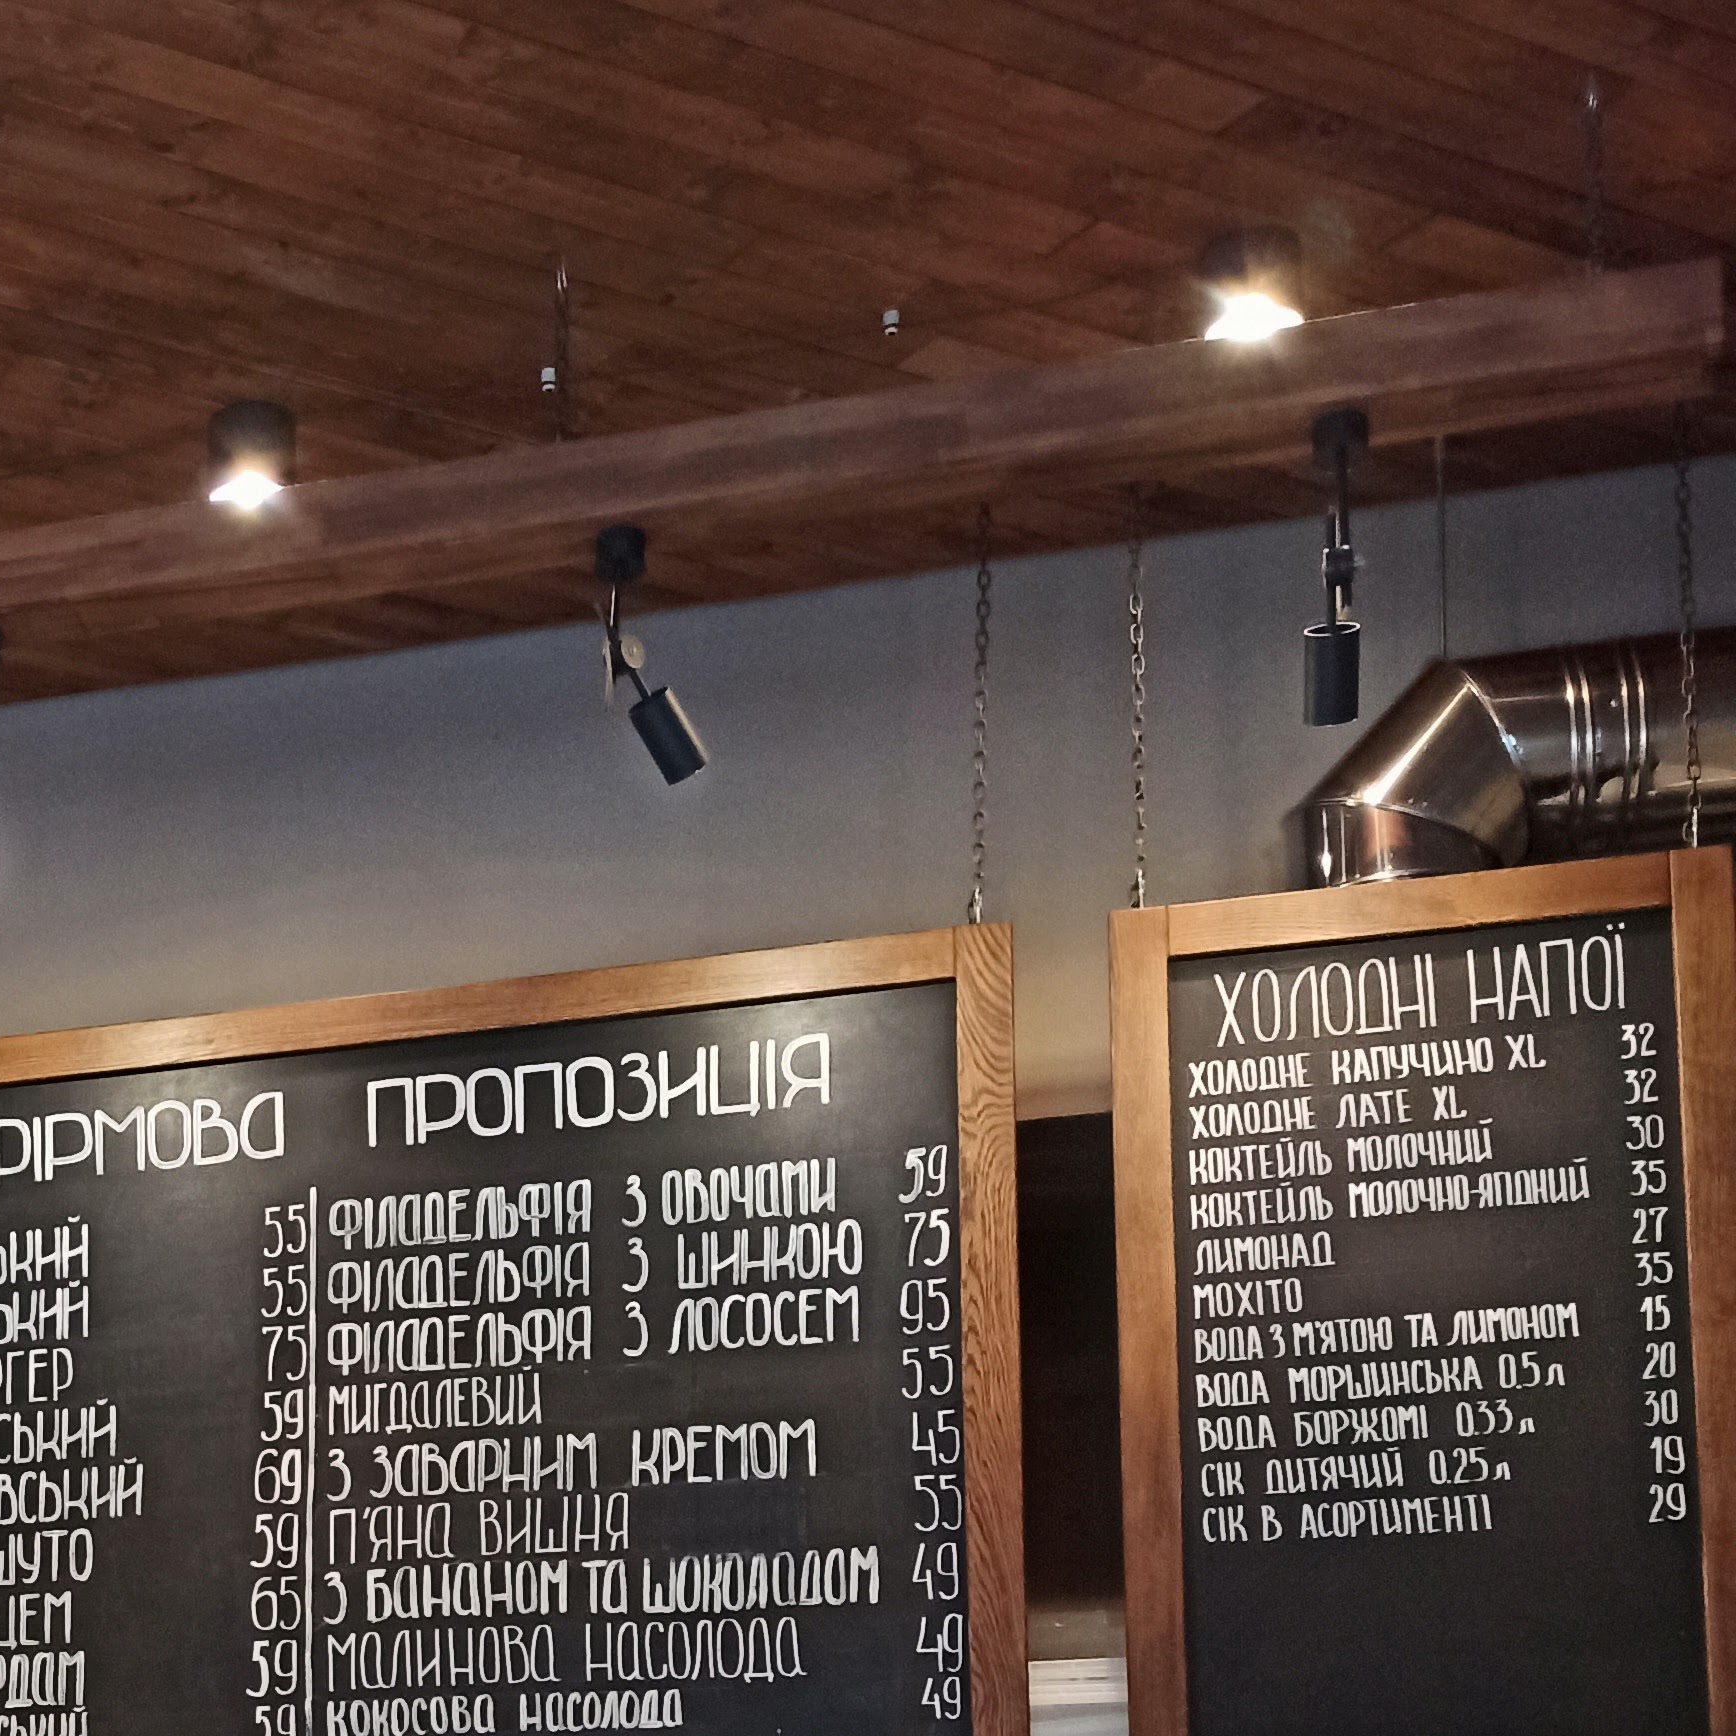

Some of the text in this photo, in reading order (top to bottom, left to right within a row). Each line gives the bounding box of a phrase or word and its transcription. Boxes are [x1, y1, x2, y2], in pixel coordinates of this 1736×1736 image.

[1214, 922, 1626, 1047] ХОЛОДНІ НАПОЇ
[1333, 1023, 1657, 1085] КАПУЧИНО 32
[367, 1033, 830, 1147] ПРОПОЗИЦІЯ
[1336, 1089, 1412, 1130] ЛАТЕ
[1189, 1115, 1664, 1185] КОКТЕЙЛЬ МОЛОЧНИЙ 30
[328, 1144, 948, 1251] ФІЛАДЕЛЬФІЯ ОВОЧАМИ 59
[263, 1204, 307, 1258] 55
[1194, 1207, 1669, 1275] ЛИМОНАД 27
[1194, 1252, 1673, 1320] МОХІТО 35
[668, 1285, 859, 1355] ЛОСОСЕМ
[1194, 1303, 1579, 1363] ВОДА ЛИМОНОМ
[262, 1324, 308, 1382] 75
[369, 1409, 961, 1498] ЗАВАРНИМ КРЕМОМ 45
[1296, 1405, 1428, 1448] БОРЖОМІ
[254, 1448, 302, 1504] 69
[1201, 1436, 1685, 1498] СІК ДИТЯЧИЙ 19
[480, 1492, 630, 1556] ВИШНЯ
[1300, 1494, 1492, 1539] АСОРТИМЕНТІ
[251, 1576, 301, 1631] 65
[366, 1545, 880, 1624] БАНАНОМ ШОКОЛАДОМ
[246, 1639, 298, 1698] 59
[585, 1613, 964, 1683] НАСОЛОДА 49
